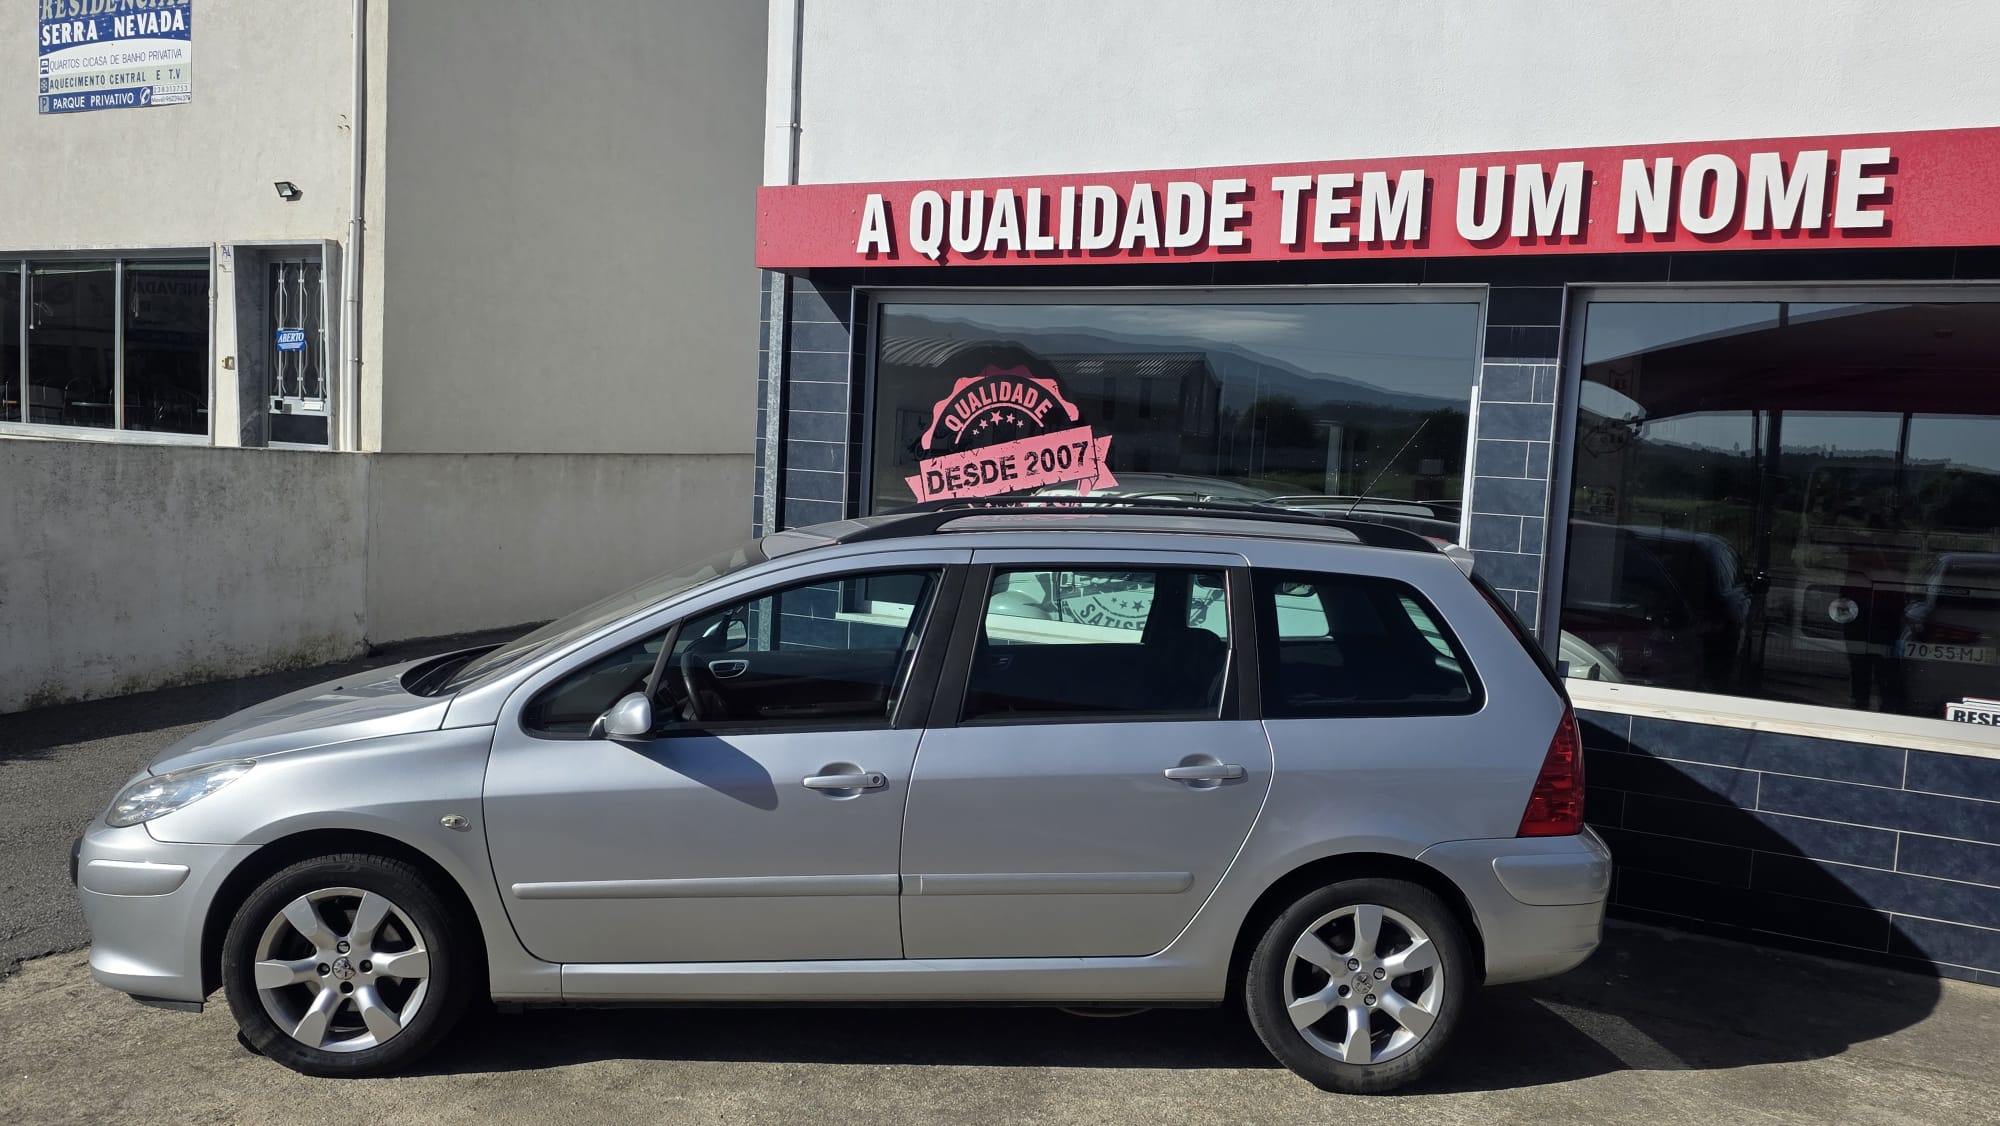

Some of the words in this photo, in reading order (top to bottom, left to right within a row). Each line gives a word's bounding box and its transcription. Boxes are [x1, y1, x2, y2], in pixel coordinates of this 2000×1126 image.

[42, 20, 98, 46] SERRA
[114, 9, 185, 38] NEVADA
[50, 59, 80, 72] QUARTOS
[110, 54, 120, 65] DE
[122, 51, 146, 63] BANHO
[148, 49, 182, 60] PRIVATIVA
[50, 75, 106, 90] AQUECIMENTO
[109, 72, 147, 85] CENTRAL
[156, 70, 161, 80] E
[53, 96, 85, 109] PARQUE
[90, 93, 134, 106] PRIVATIVO
[856, 194, 890, 253] A
[909, 178, 1247, 261] QUALIDADE
[1271, 170, 1425, 245] TEM
[1456, 161, 1584, 241] UM
[1616, 147, 1891, 235] NOME
[277, 333, 305, 343] ABERTO
[945, 381, 1053, 432] QUALIDADE
[926, 454, 1018, 495] DESDE
[1024, 441, 1089, 476] 2007
